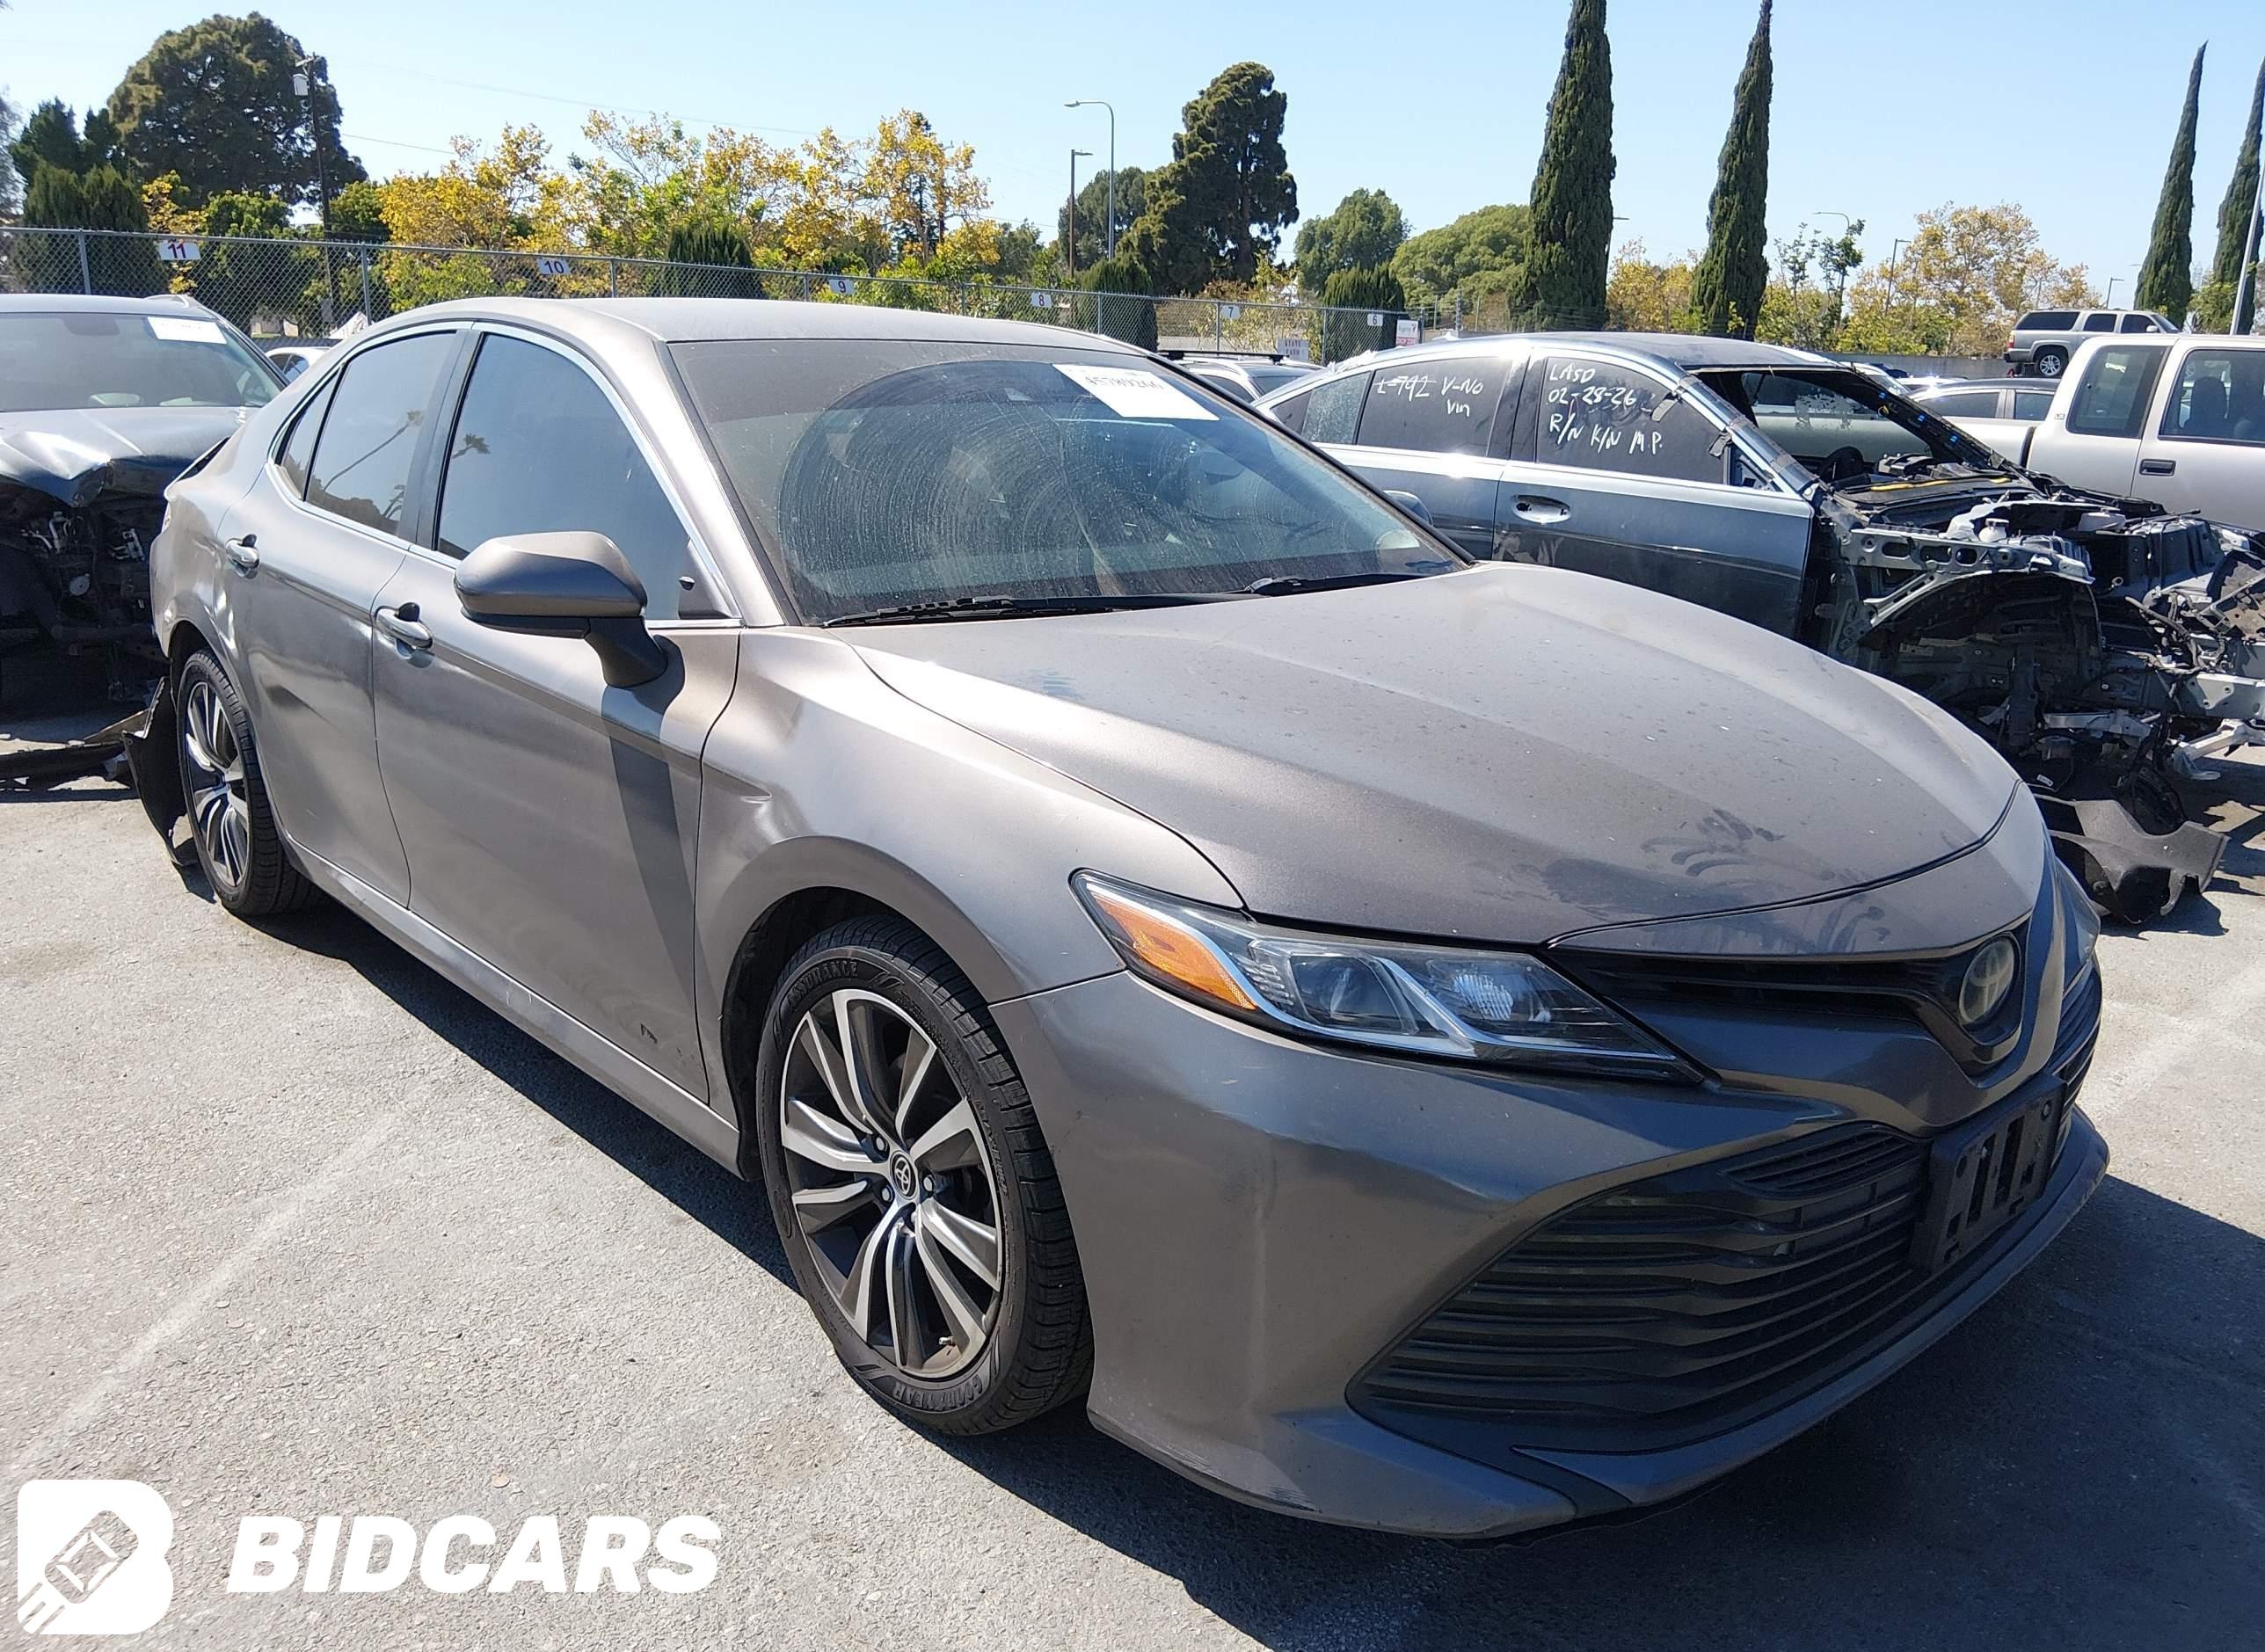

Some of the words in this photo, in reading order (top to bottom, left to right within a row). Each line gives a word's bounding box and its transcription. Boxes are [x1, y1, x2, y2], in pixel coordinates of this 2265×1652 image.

[167, 243, 186, 258] 11
[544, 260, 564, 273] 10
[837, 280, 847, 293] 9
[1038, 295, 1045, 306] 8
[1227, 306, 1234, 317] 7
[1372, 314, 1378, 325] 6
[1549, 363, 1596, 384] LASD
[1548, 385, 1637, 406] 02-28-26
[1548, 412, 1585, 446] R/N
[1590, 424, 1622, 454] K/N
[787, 960, 859, 1006] ASSURANCE
[892, 1373, 983, 1412] GOODYEAR
